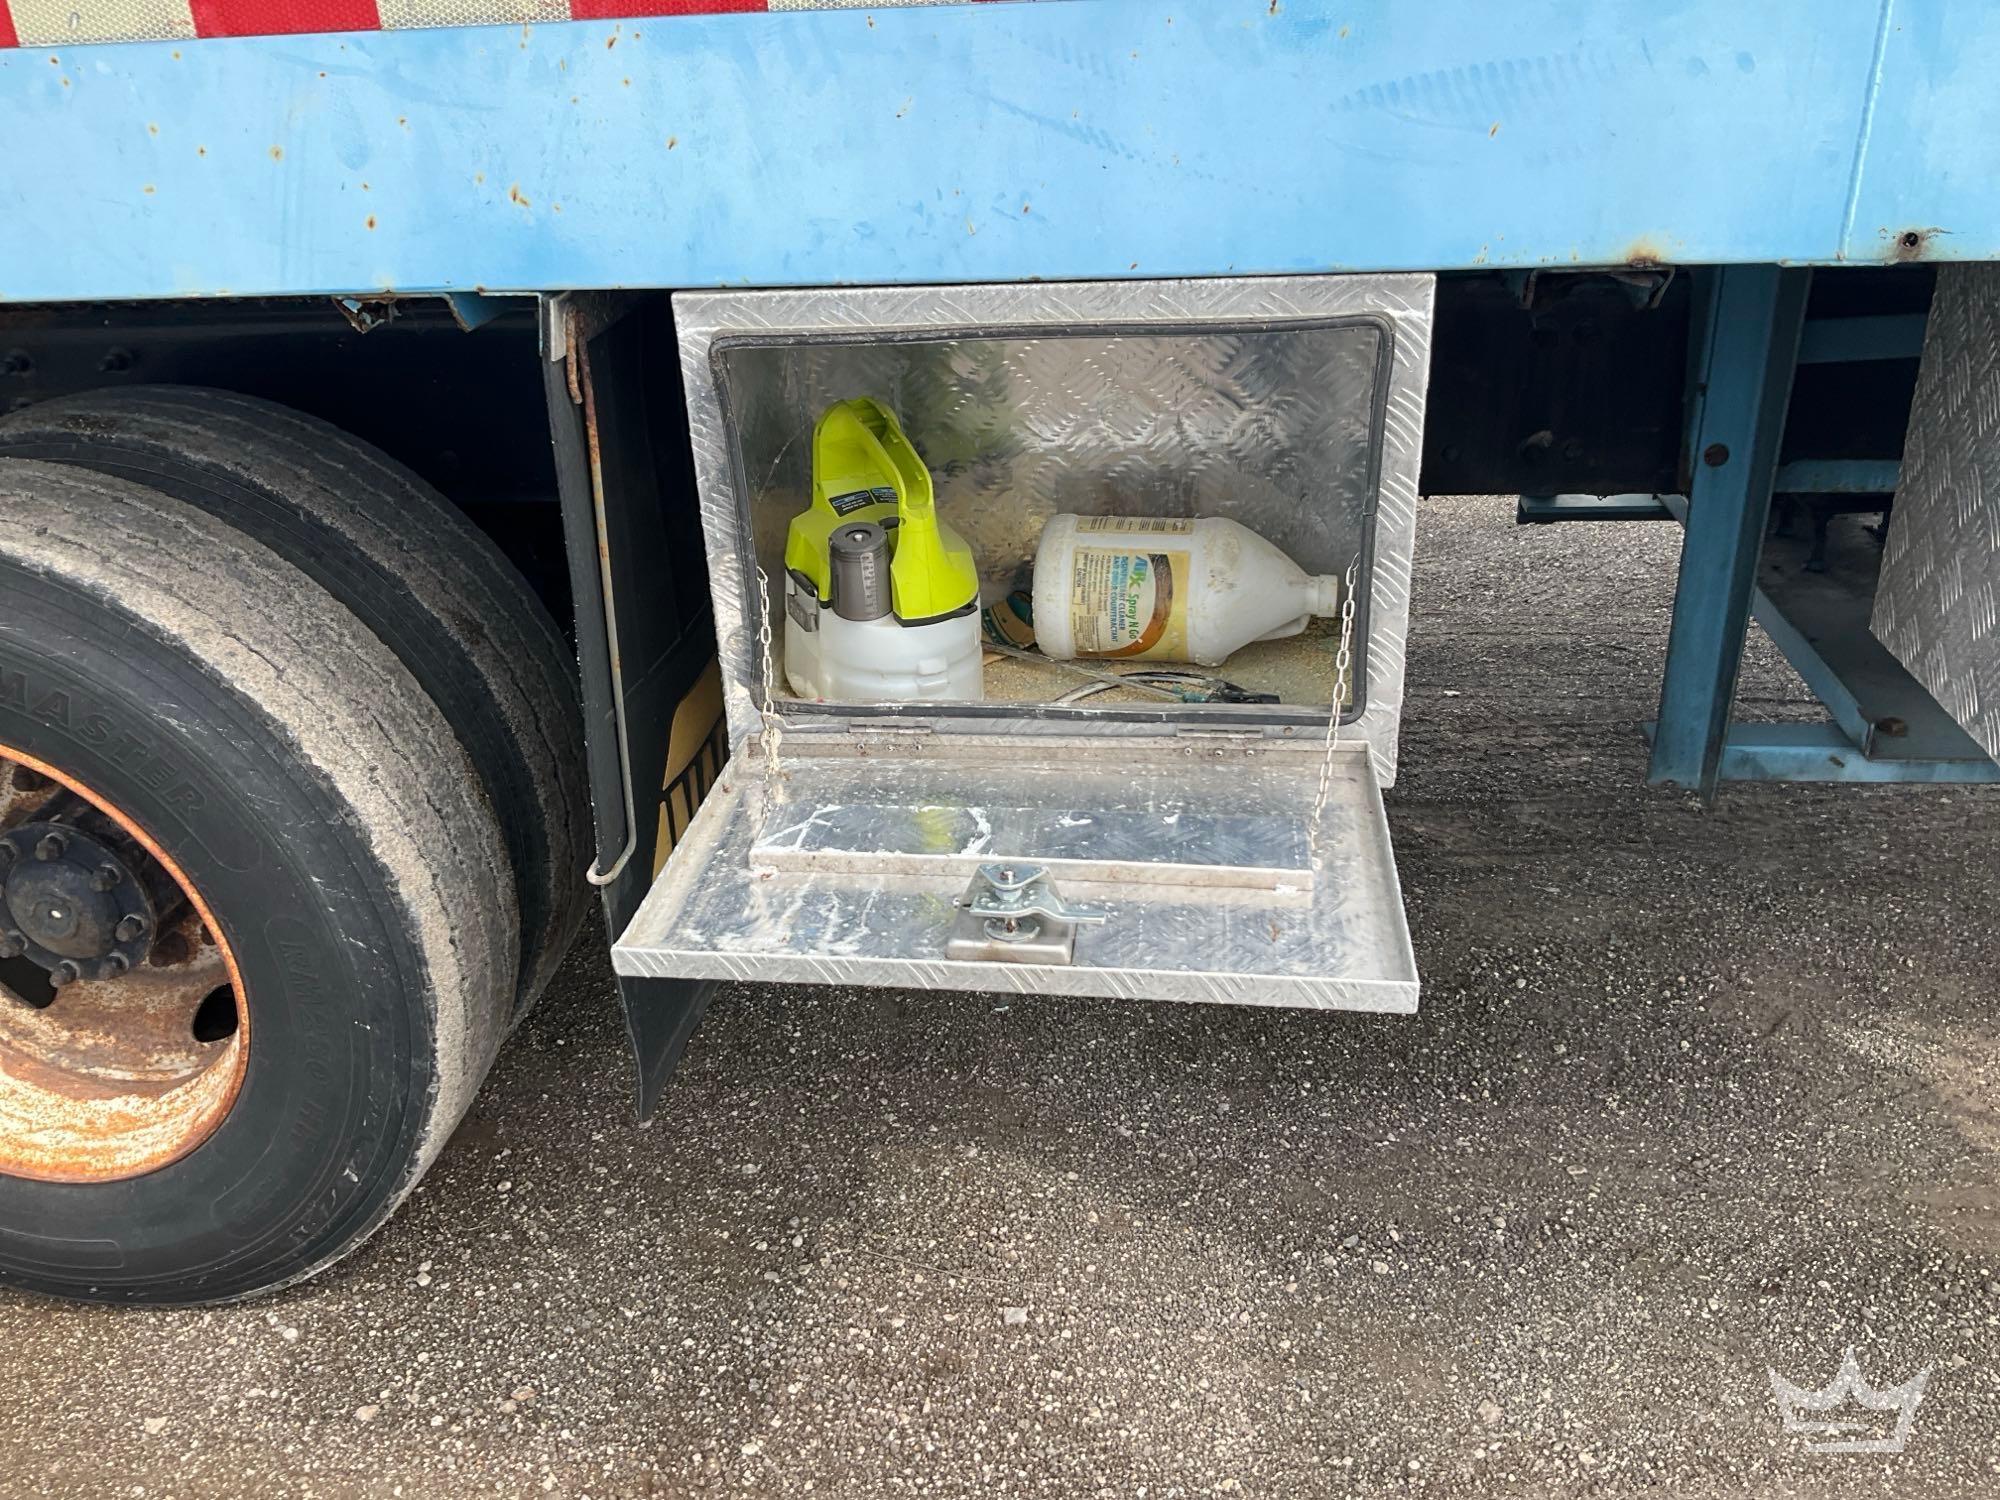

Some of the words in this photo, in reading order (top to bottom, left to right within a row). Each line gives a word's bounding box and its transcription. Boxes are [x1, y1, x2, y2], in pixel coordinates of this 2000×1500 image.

[1110, 592, 1118, 642] COUNTERACTANT
[1127, 594, 1139, 619] Spray
[1130, 630, 1139, 640] Go
